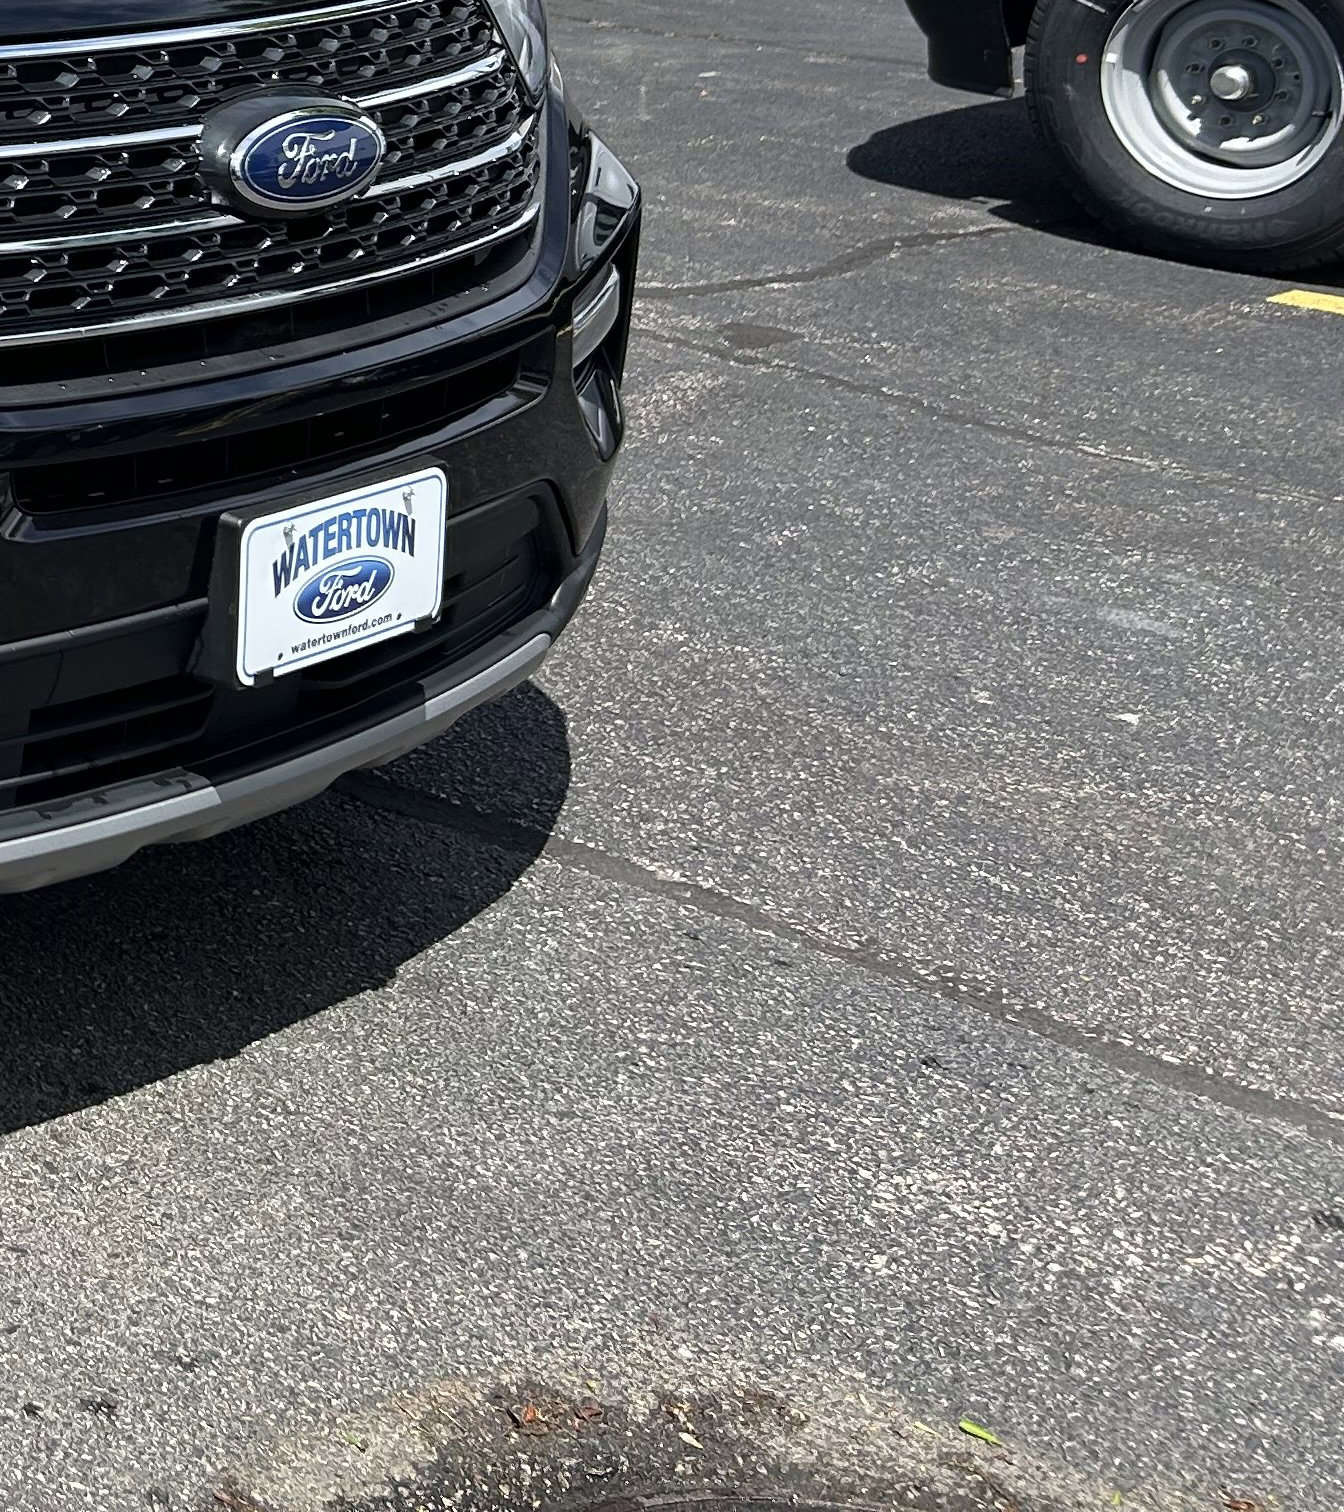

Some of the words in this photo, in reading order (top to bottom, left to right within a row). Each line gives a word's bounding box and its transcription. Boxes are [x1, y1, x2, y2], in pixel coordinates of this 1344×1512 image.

[276, 129, 358, 189] Ford
[271, 506, 416, 598] WATERTOWN
[312, 565, 378, 617] Ford
[290, 610, 393, 655] watertownford.com
